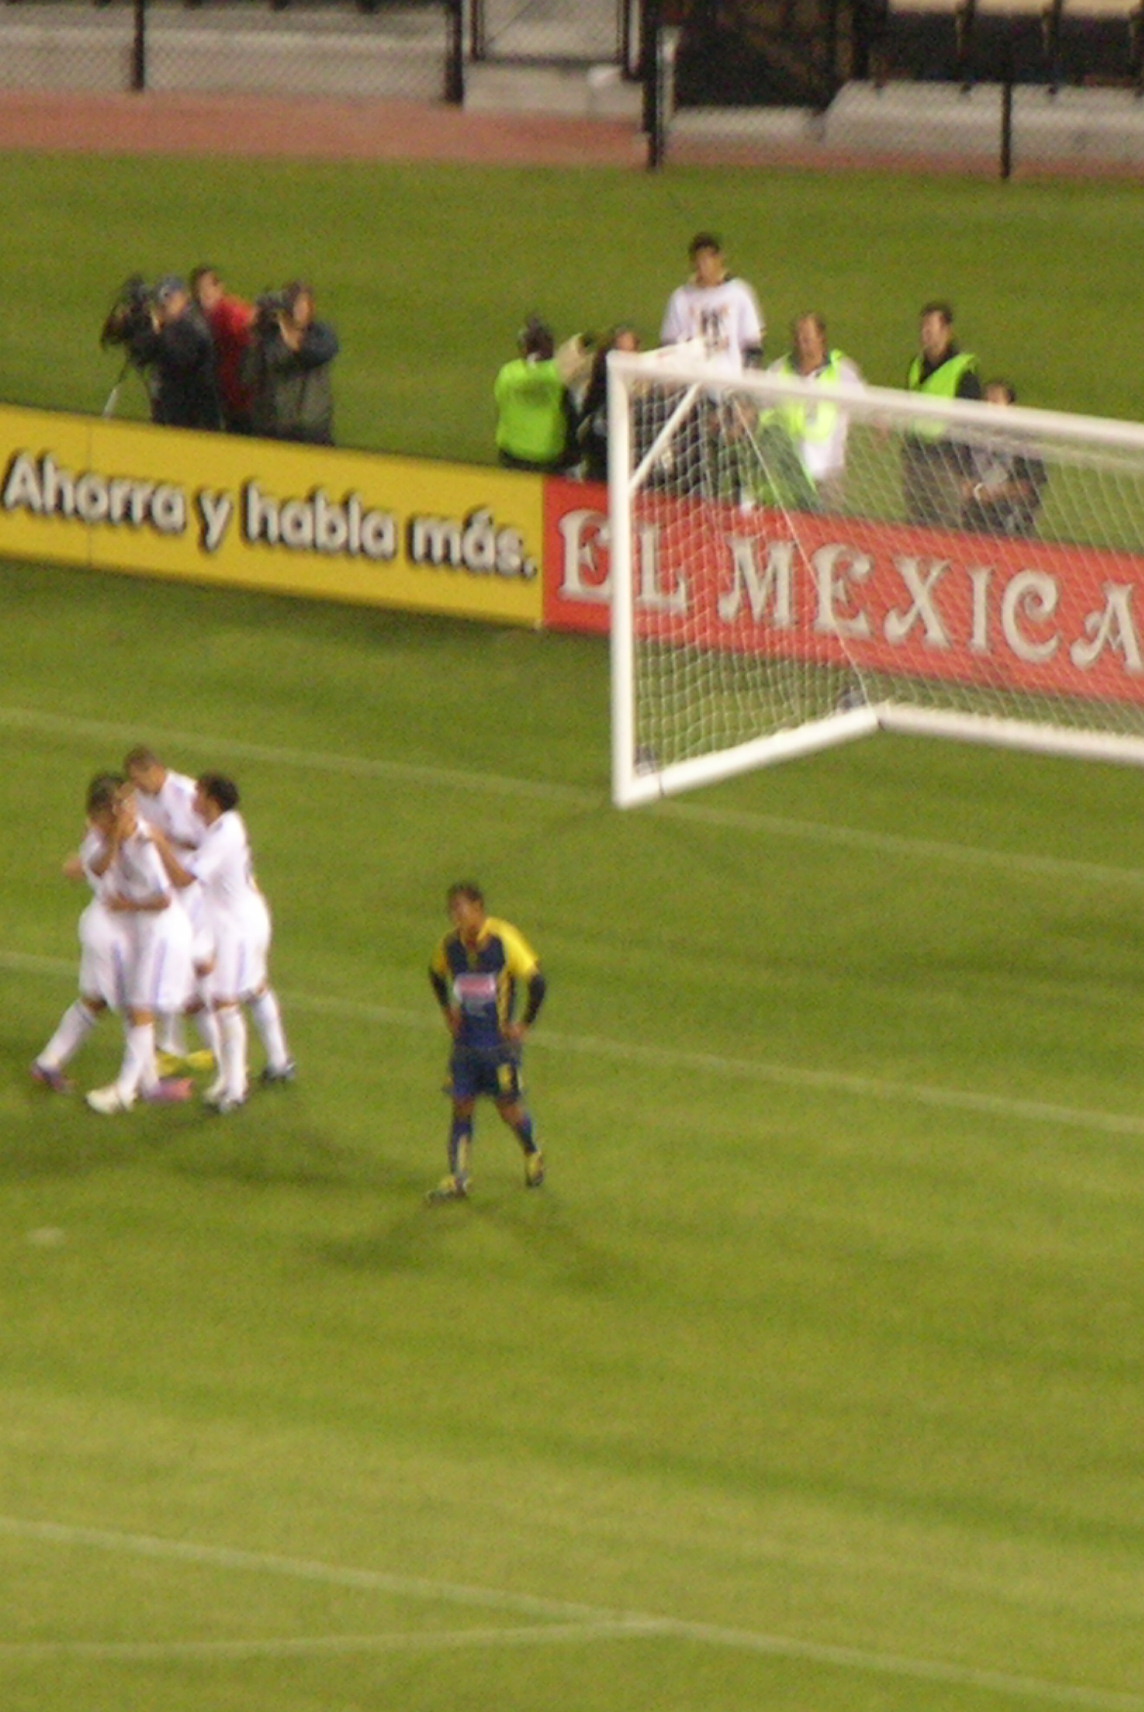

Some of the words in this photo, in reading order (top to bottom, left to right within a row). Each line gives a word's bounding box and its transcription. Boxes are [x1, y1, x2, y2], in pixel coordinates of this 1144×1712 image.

[3, 450, 186, 535] Ahorra
[198, 491, 232, 552] y
[242, 482, 397, 561] habla
[411, 508, 538, 580] más.
[558, 508, 692, 614] EL
